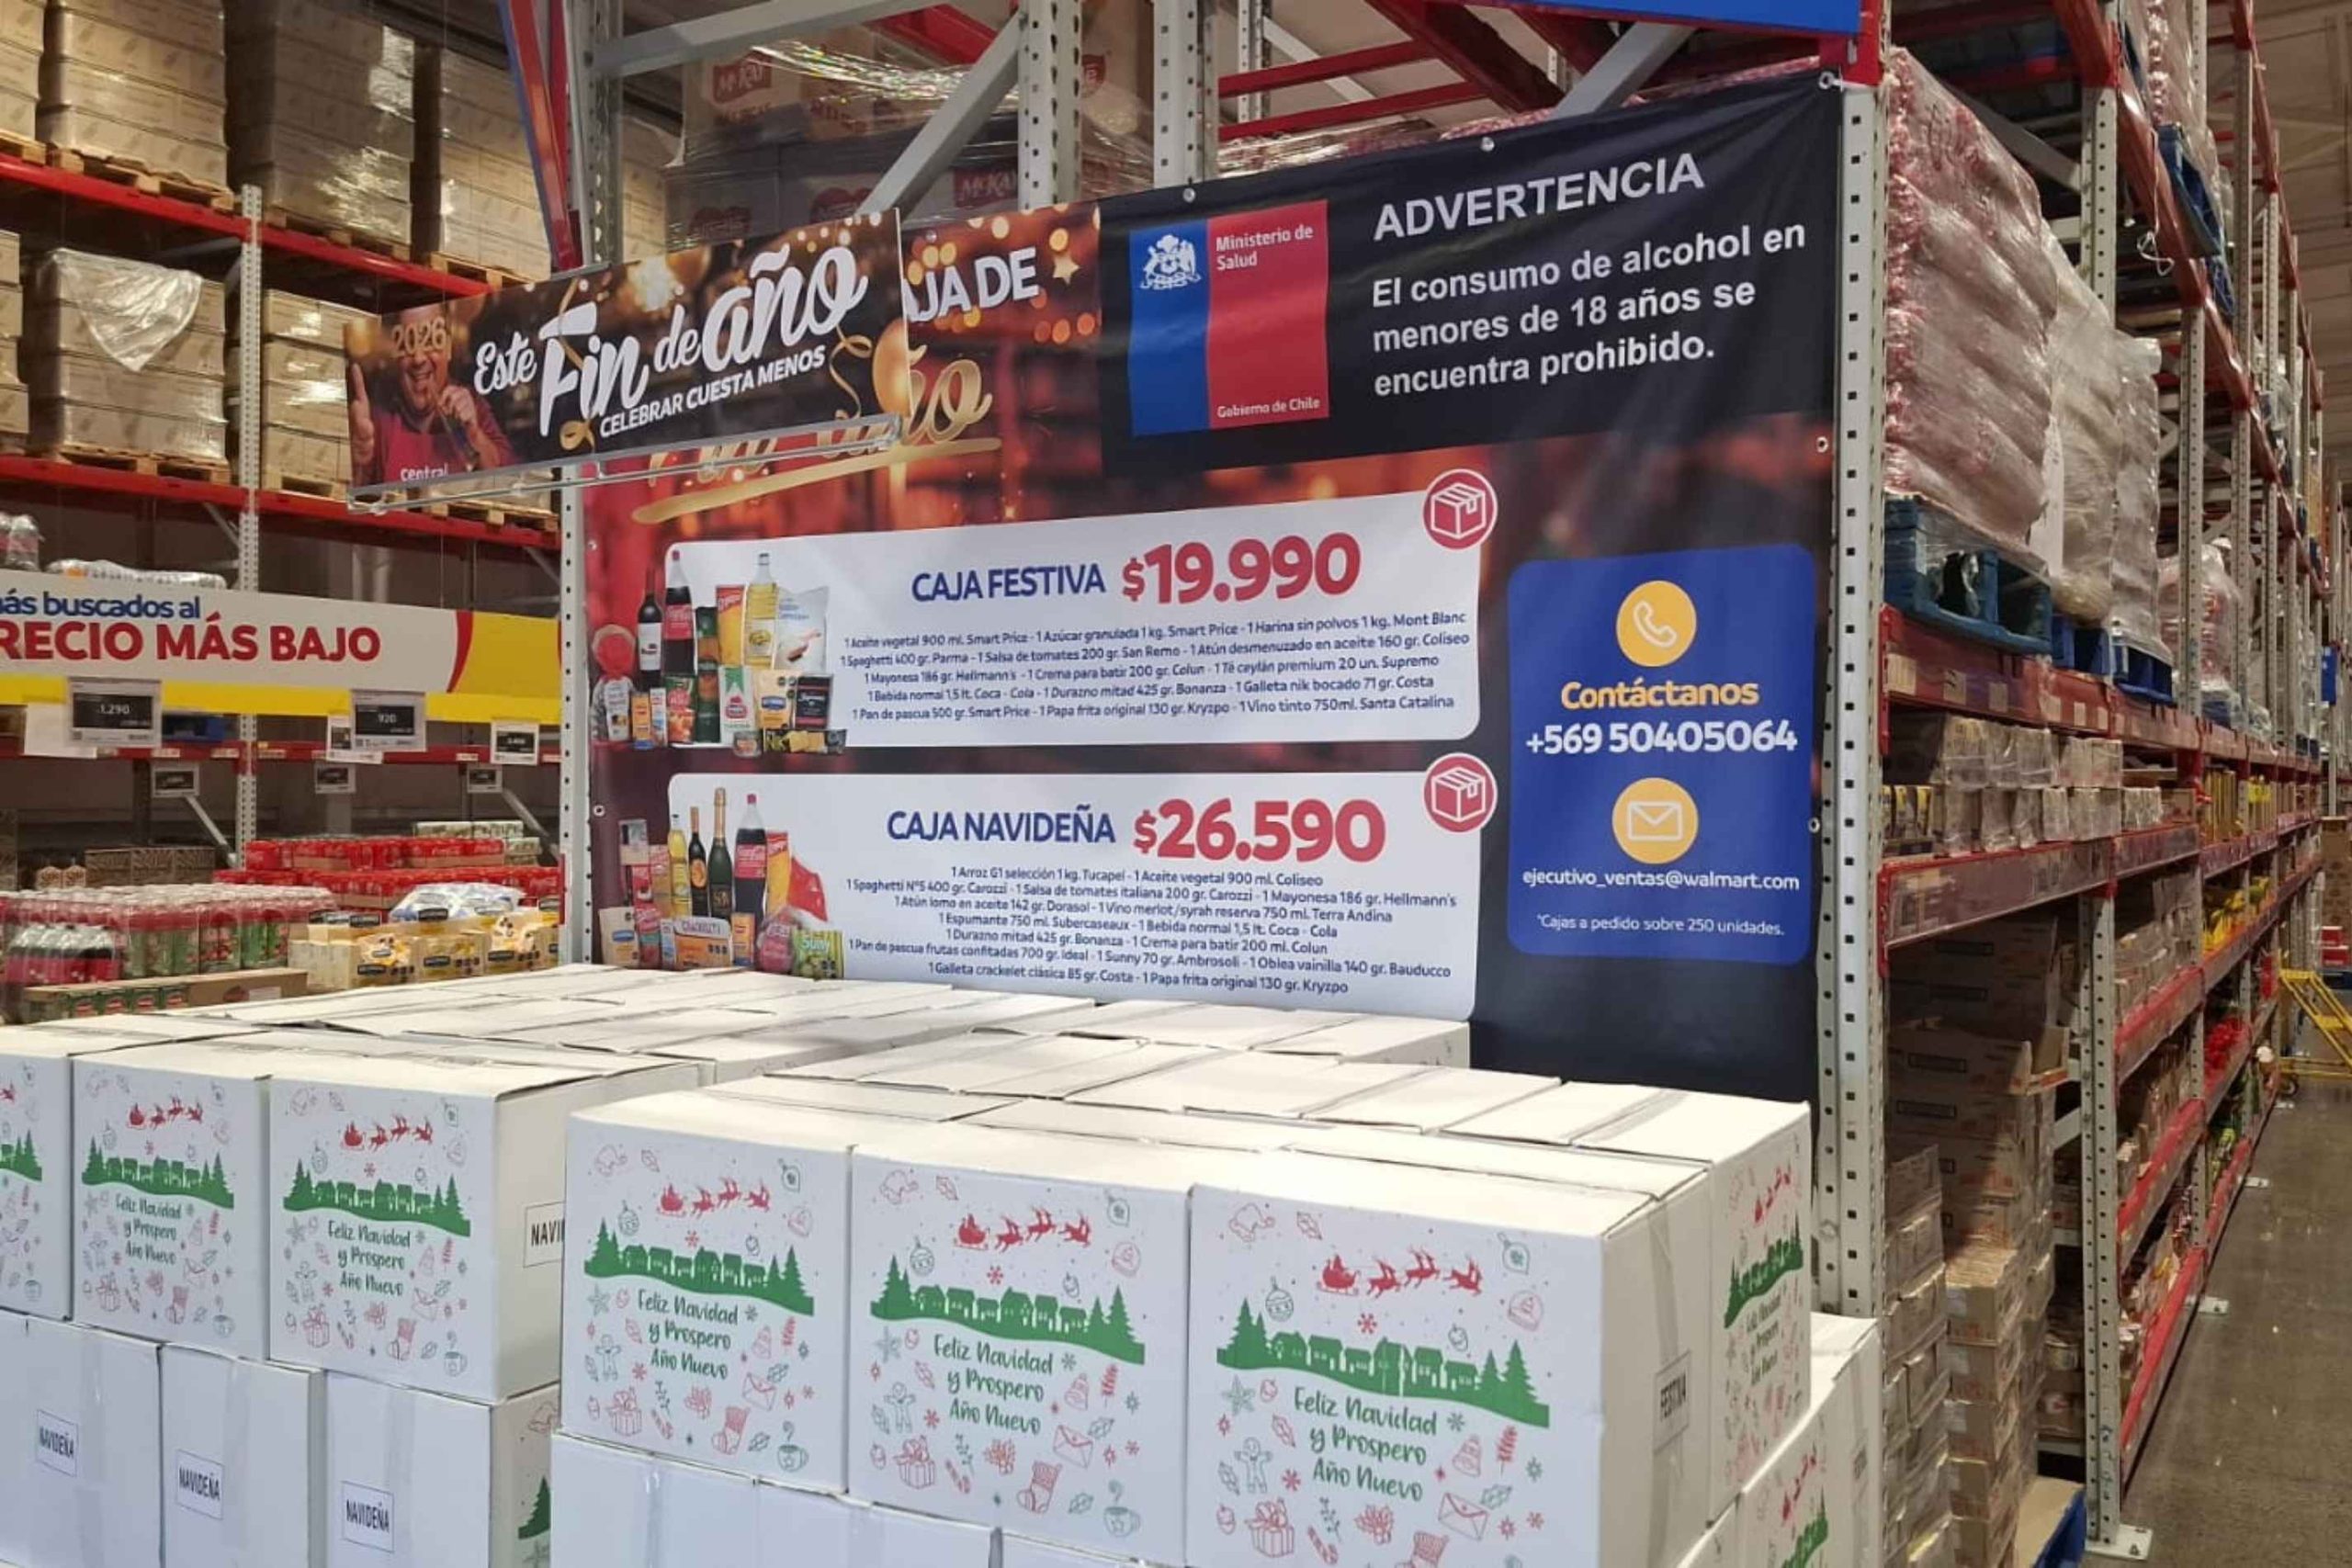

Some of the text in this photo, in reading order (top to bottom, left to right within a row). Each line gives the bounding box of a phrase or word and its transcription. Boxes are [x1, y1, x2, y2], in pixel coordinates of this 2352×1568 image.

[1374, 152, 1705, 241] ADVERTENCIA
[1216, 224, 1313, 252] Ministerio de
[975, 246, 1039, 308] DE
[1216, 252, 1258, 271] Salud
[1373, 224, 1805, 307] El consumo de alcohol en
[1374, 281, 1755, 353] menores de 18 años se
[391, 317, 447, 357] 2026
[474, 244, 868, 436] Este Fin de año
[1374, 332, 1714, 396] encuentra prohibido.
[599, 344, 827, 440] CELEBRAR CUESTA MENOS
[1217, 398, 1320, 418] Gobierno de Chile
[400, 464, 449, 480] central
[911, 532, 1361, 604] CAJA FESTIVA $19.990
[43, 592, 174, 619] buscados
[179, 596, 200, 619] al
[157, 611, 258, 661] MÁS
[270, 625, 381, 662] BAJO
[1169, 626, 1205, 637] Smart
[1208, 622, 1238, 636] Price
[1316, 616, 1359, 632] polvos
[1394, 614, 1429, 626] Mont
[1431, 611, 1466, 625] Blanc
[1422, 632, 1470, 646] Coliseo
[1277, 659, 1336, 673] premium
[1381, 656, 1439, 671] Supremo
[1313, 678, 1362, 691] bocado
[1396, 676, 1434, 688] Costa
[1561, 678, 1759, 710] Contáctanos
[1103, 703, 1146, 717] original
[1279, 698, 1311, 712] tinto
[1361, 697, 1396, 709] Santa
[1399, 694, 1454, 709] Catalina
[1526, 719, 1798, 754] +569 50405064
[888, 797, 1386, 863] CAJA NAVIDEÑA $26.590
[1182, 873, 1225, 886] vegetal
[1227, 874, 1252, 884] 900
[1276, 874, 1323, 886] Coliseo
[1522, 868, 1800, 890] ejecutivo_ventas@walmart.com
[1272, 890, 1338, 905] Mayonesa
[1340, 892, 1362, 904] 186
[1216, 908, 1261, 918] reserva
[1312, 908, 1344, 920] Terra
[1347, 909, 1393, 922] Andina
[1269, 924, 1299, 935] Coca
[1310, 925, 1338, 937] Cola
[1579, 919, 1588, 929] a
[1591, 915, 1640, 932] pedido
[1644, 915, 1684, 931] sobre
[1688, 919, 1714, 931] 250
[1718, 920, 1784, 935] unidades.
[1292, 942, 1328, 953] Colun
[1211, 975, 1257, 990] original
[1389, 963, 1451, 976] Bauducco
[328, 1220, 411, 1247] Feliz Navidad
[638, 1289, 738, 1325] Feliz Navidad
[649, 1319, 731, 1350] y Prospero
[650, 1348, 728, 1380] Año Nuevo
[933, 1334, 1054, 1375] Feliz Navidad
[948, 1367, 1044, 1402] y Prospero
[950, 1398, 1041, 1435] Año Nuevo
[1295, 1386, 1437, 1436] Feliz Navidad
[39, 1426, 74, 1459] NAVIDEÑA
[1309, 1424, 1426, 1466] y Prospero
[178, 1466, 220, 1502] NAVIDEÑA
[1314, 1458, 1422, 1502] Año Nuevo
[345, 1499, 390, 1533] NAVIDEÑA
